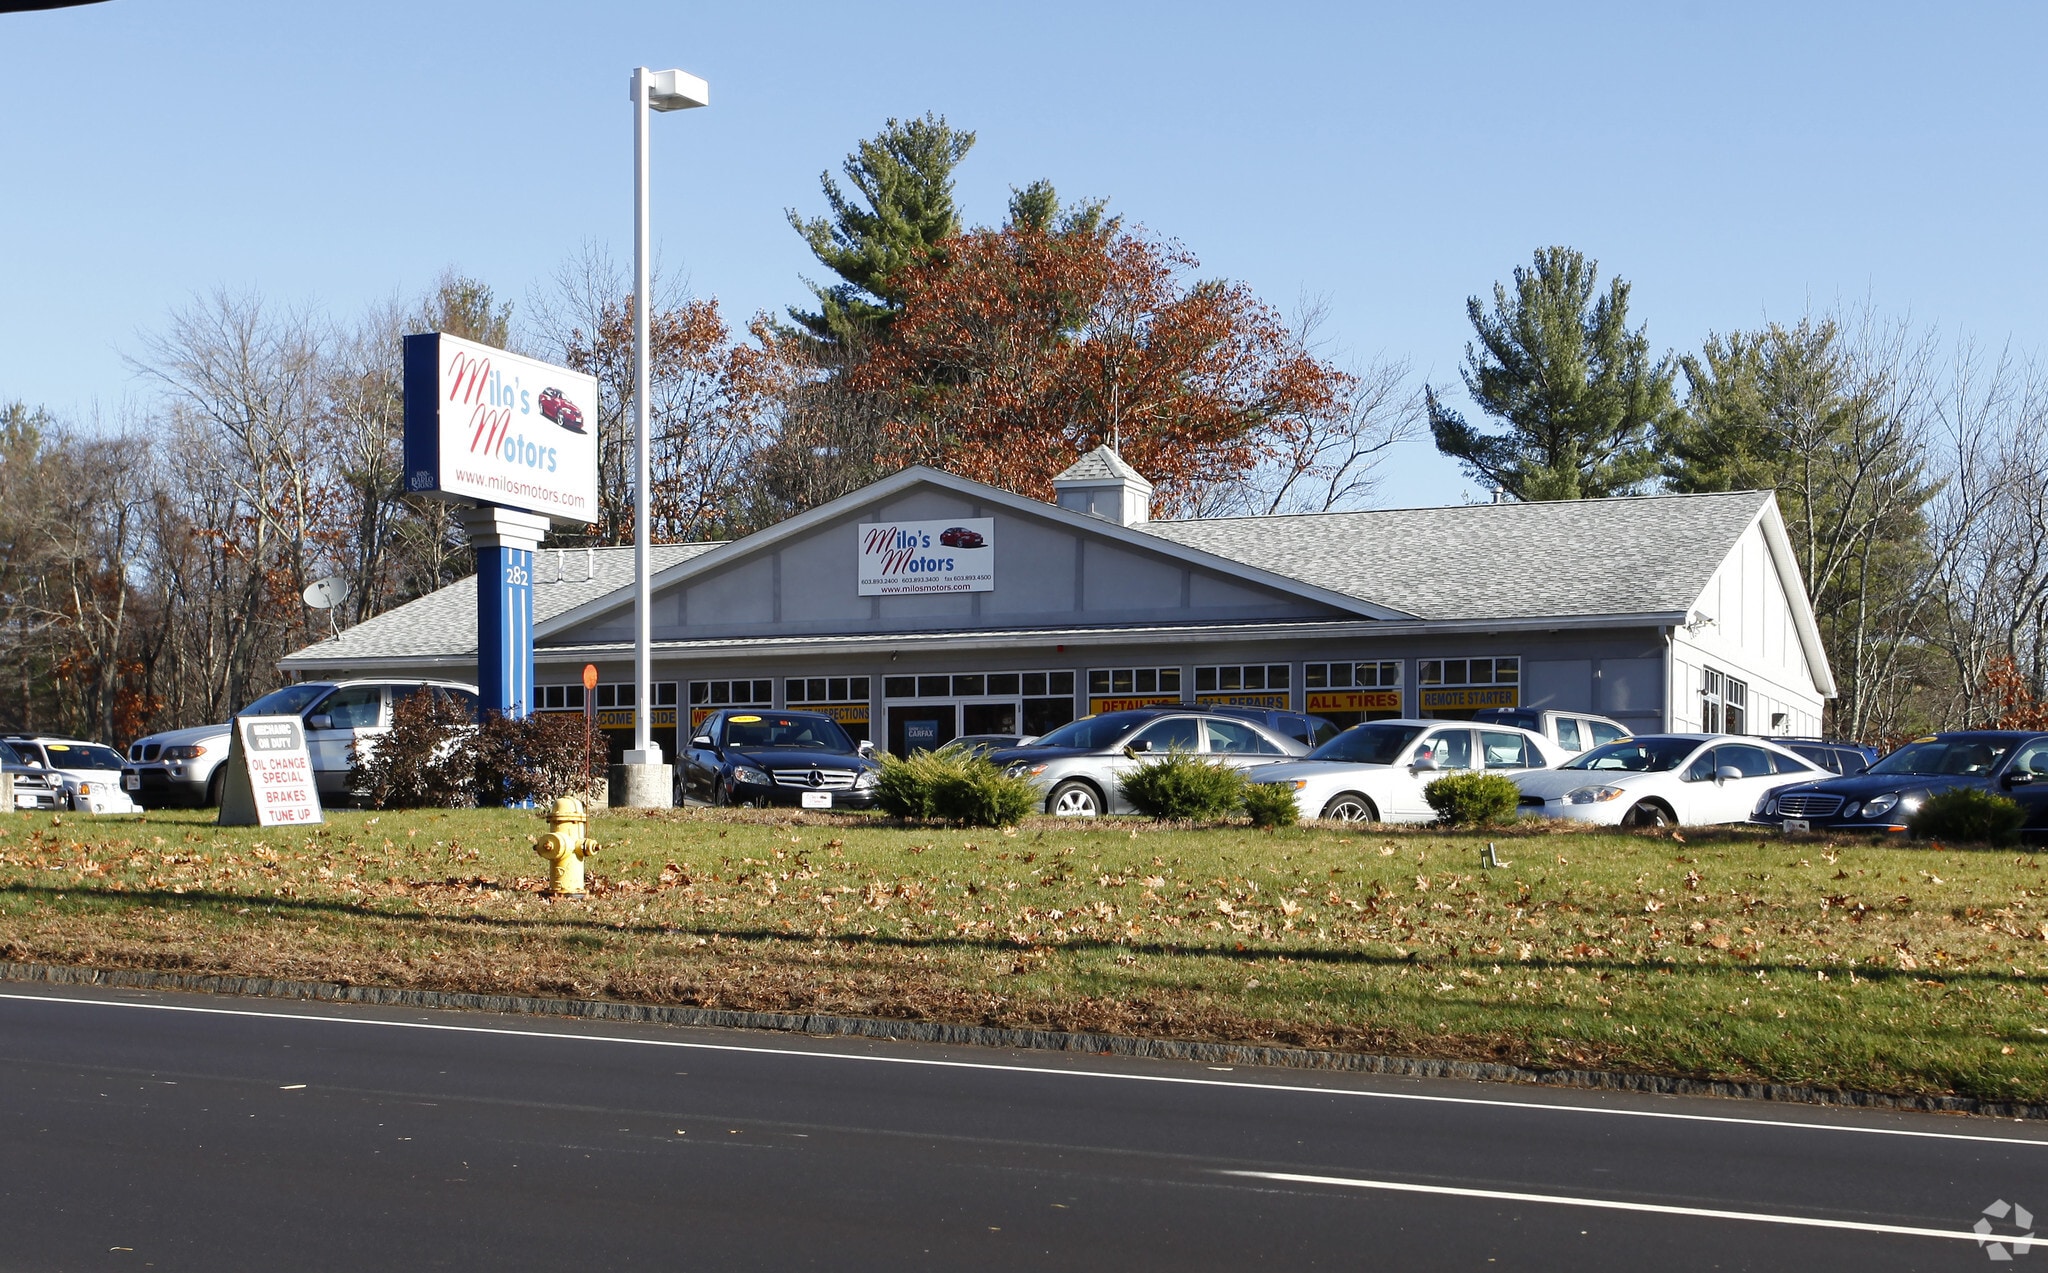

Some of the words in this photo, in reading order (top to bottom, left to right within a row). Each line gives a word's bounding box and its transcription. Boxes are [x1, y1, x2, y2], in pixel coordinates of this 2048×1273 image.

[449, 352, 530, 415] Milo's
[469, 402, 557, 473] Motors
[456, 467, 585, 509] www.milosmotors.com
[864, 526, 931, 555] Milo's
[881, 547, 954, 576] Motors
[506, 565, 529, 587] 282
[881, 583, 971, 594] www.milosmotors.com
[1309, 696, 1342, 709] ALL
[1346, 694, 1398, 708] TIRES
[1424, 692, 1465, 706] REMOTE
[1468, 691, 1512, 705] STARTER
[600, 712, 633, 725] COME
[650, 711, 677, 724] SIDE
[815, 707, 869, 720] PECTIONS
[253, 723, 292, 736] MECHANIC
[908, 729, 934, 738] CARFAX
[257, 738, 270, 749] ON
[271, 737, 292, 749] DUTY
[252, 759, 267, 770] OIL
[269, 758, 306, 770] CHANGE
[262, 771, 304, 784] SPECIAL
[266, 790, 307, 803] BRAKES
[269, 809, 295, 822] TUNE
[298, 808, 311, 820] UP
